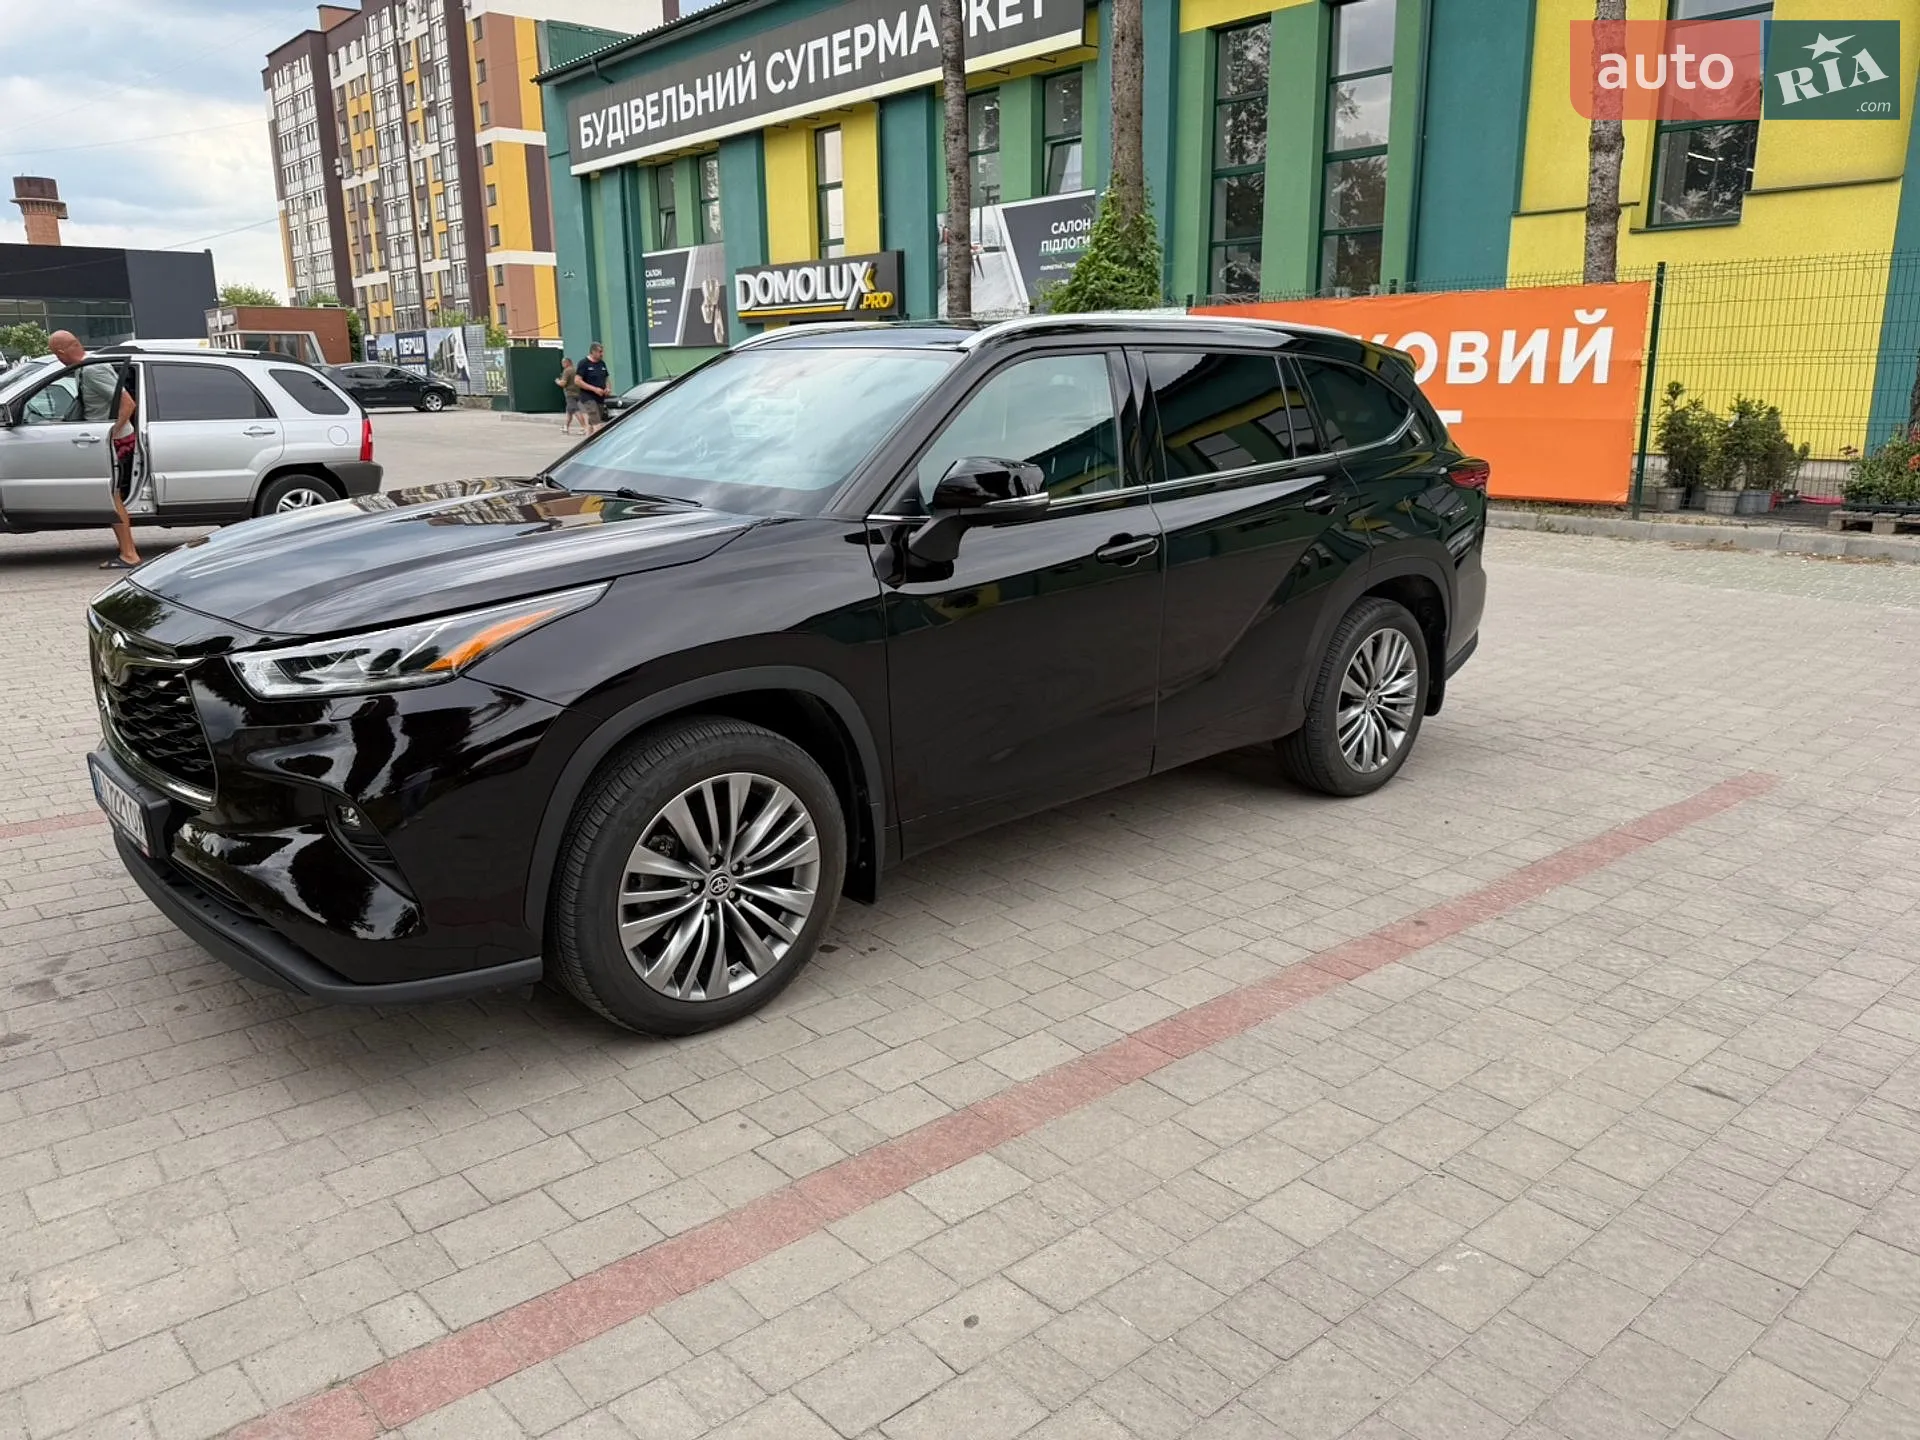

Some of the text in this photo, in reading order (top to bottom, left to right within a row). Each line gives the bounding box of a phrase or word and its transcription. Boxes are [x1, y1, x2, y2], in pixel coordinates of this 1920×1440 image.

[579, 0, 1043, 149] БУДІВЕЛЬНИЙ СУПЕРМАКЕ
[1051, 218, 1091, 235] САЛОН
[1041, 235, 1091, 253] ПІДЛОГИ
[735, 261, 870, 311] DOMOLUX
